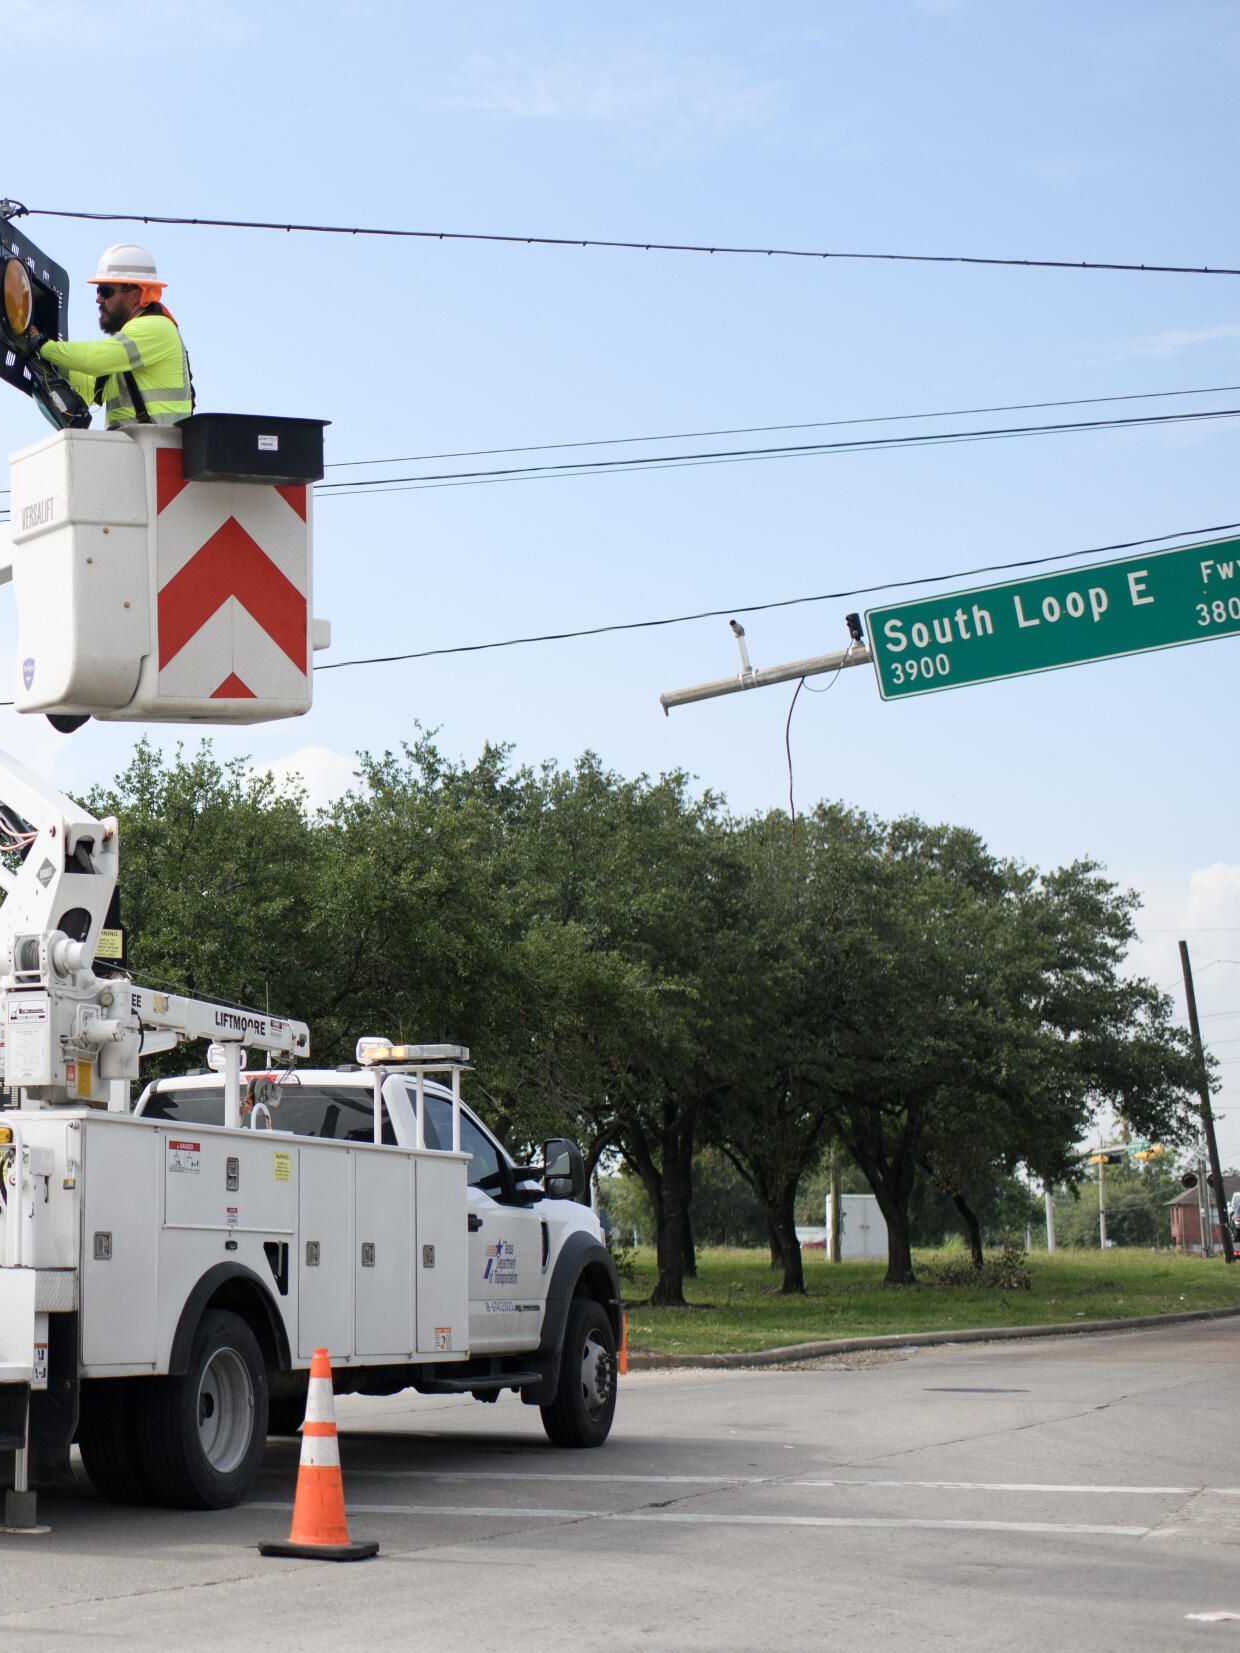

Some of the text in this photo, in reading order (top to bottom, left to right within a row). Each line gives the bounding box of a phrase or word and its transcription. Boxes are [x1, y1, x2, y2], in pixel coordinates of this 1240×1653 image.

[21, 496, 54, 531] VERSALIFT
[883, 559, 1240, 653] South Loop E Fw
[890, 652, 951, 685] 3900
